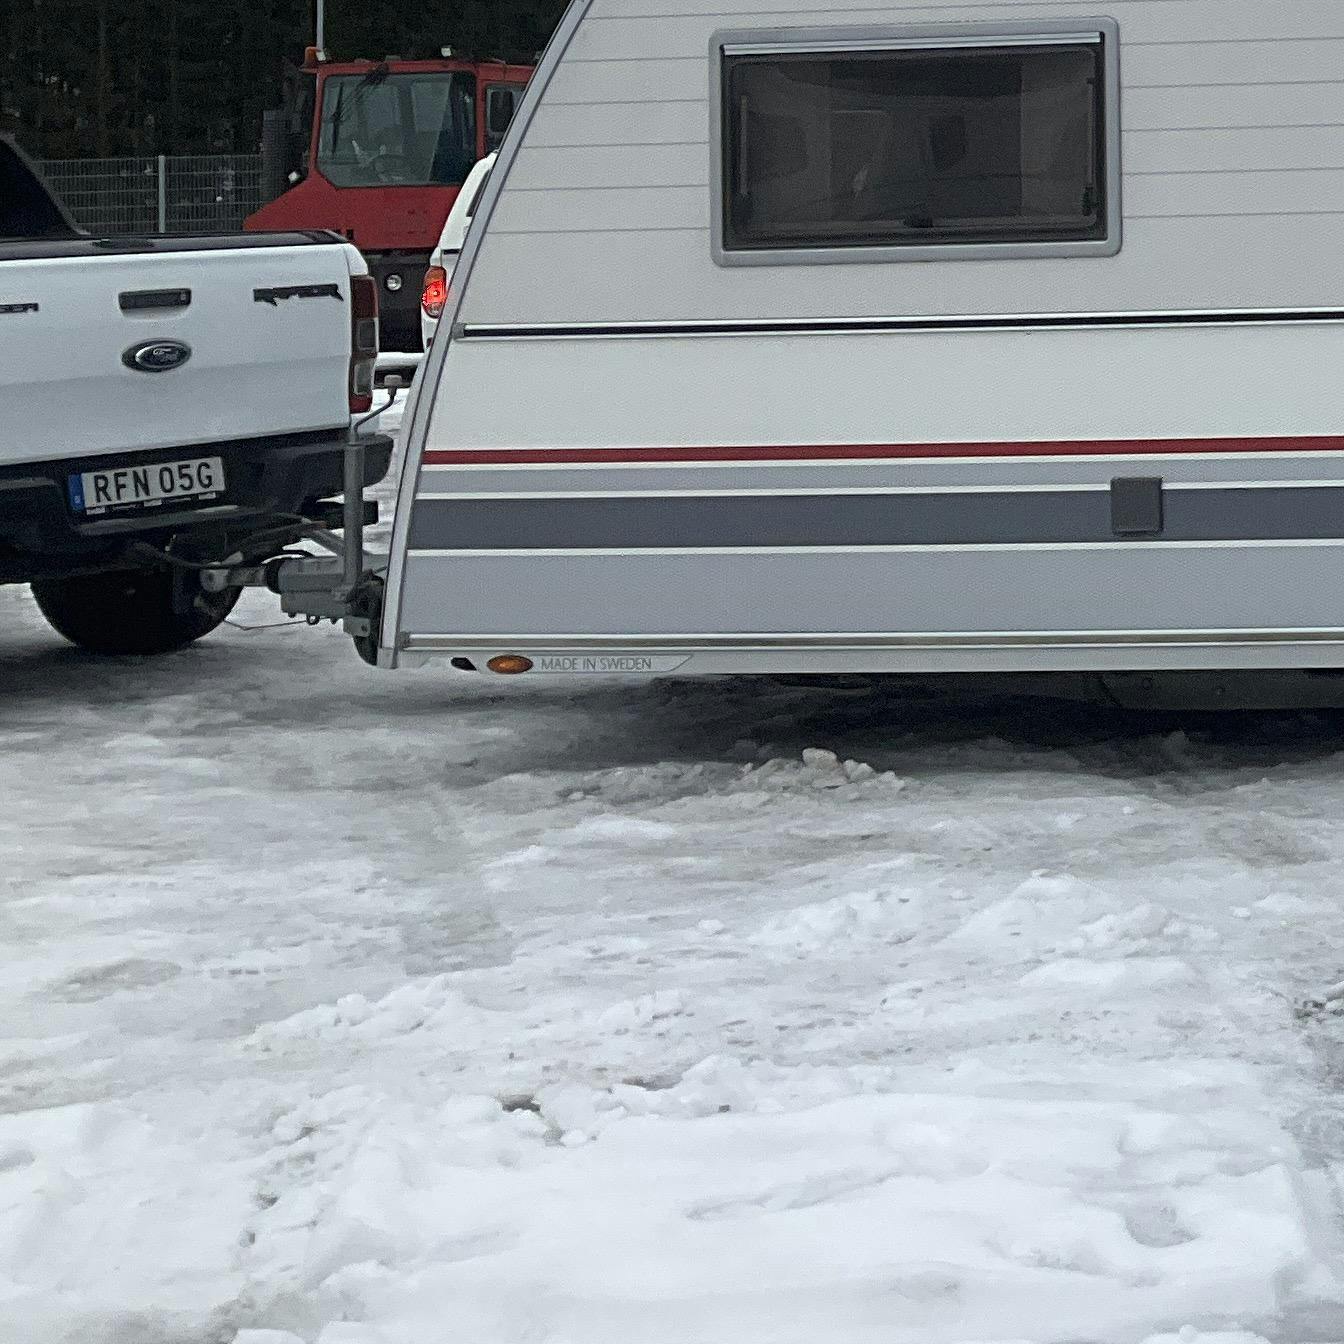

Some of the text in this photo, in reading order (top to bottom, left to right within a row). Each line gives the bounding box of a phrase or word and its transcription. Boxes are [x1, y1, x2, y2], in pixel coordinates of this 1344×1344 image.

[94, 462, 213, 503] RFN 05G
[541, 657, 652, 670] MADE IN SWEDEN
